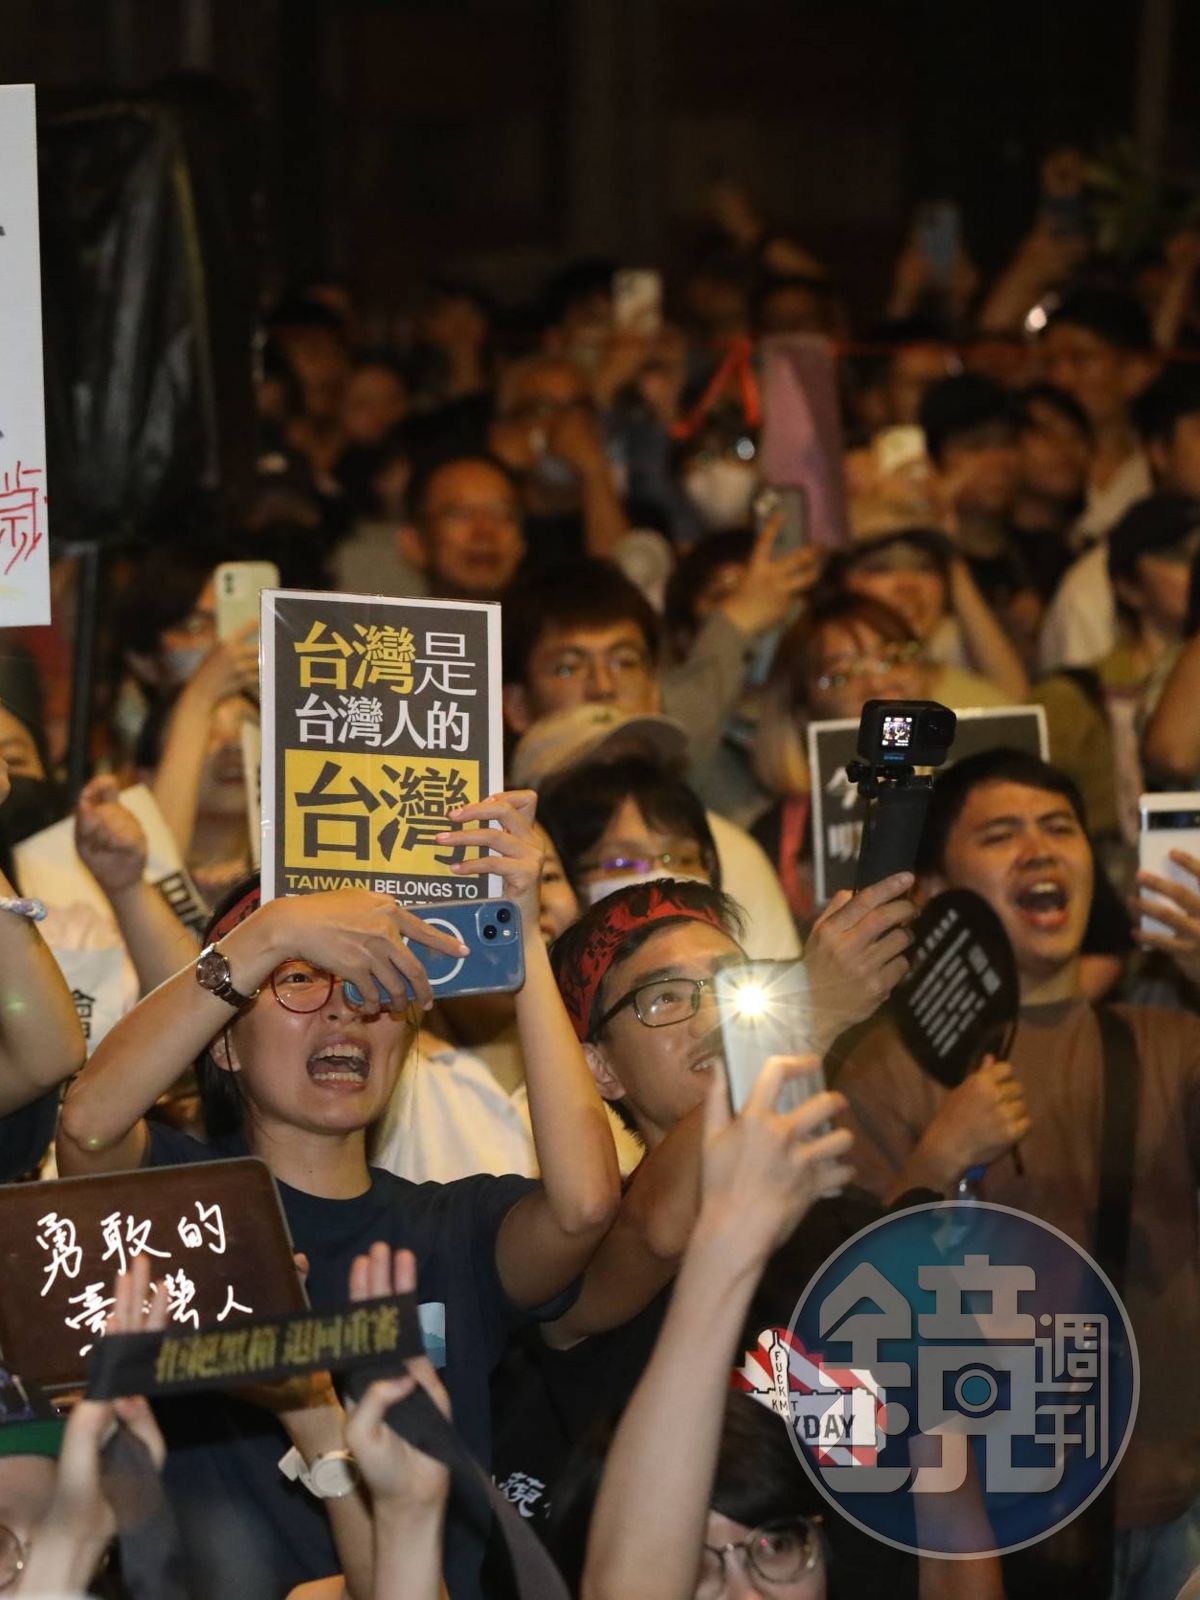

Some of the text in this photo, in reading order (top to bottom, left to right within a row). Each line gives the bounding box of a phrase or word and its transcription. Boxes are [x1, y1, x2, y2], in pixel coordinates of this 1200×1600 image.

[294, 620, 478, 696] 台灣是
[295, 693, 470, 751] 台灣人的
[294, 760, 471, 866] 台灣
[285, 874, 479, 899] TAIWAN BELONGS TO
[36, 1200, 227, 1297] 勇敢的
[774, 1350, 788, 1398] FUCK
[771, 1400, 799, 1413] KMT
